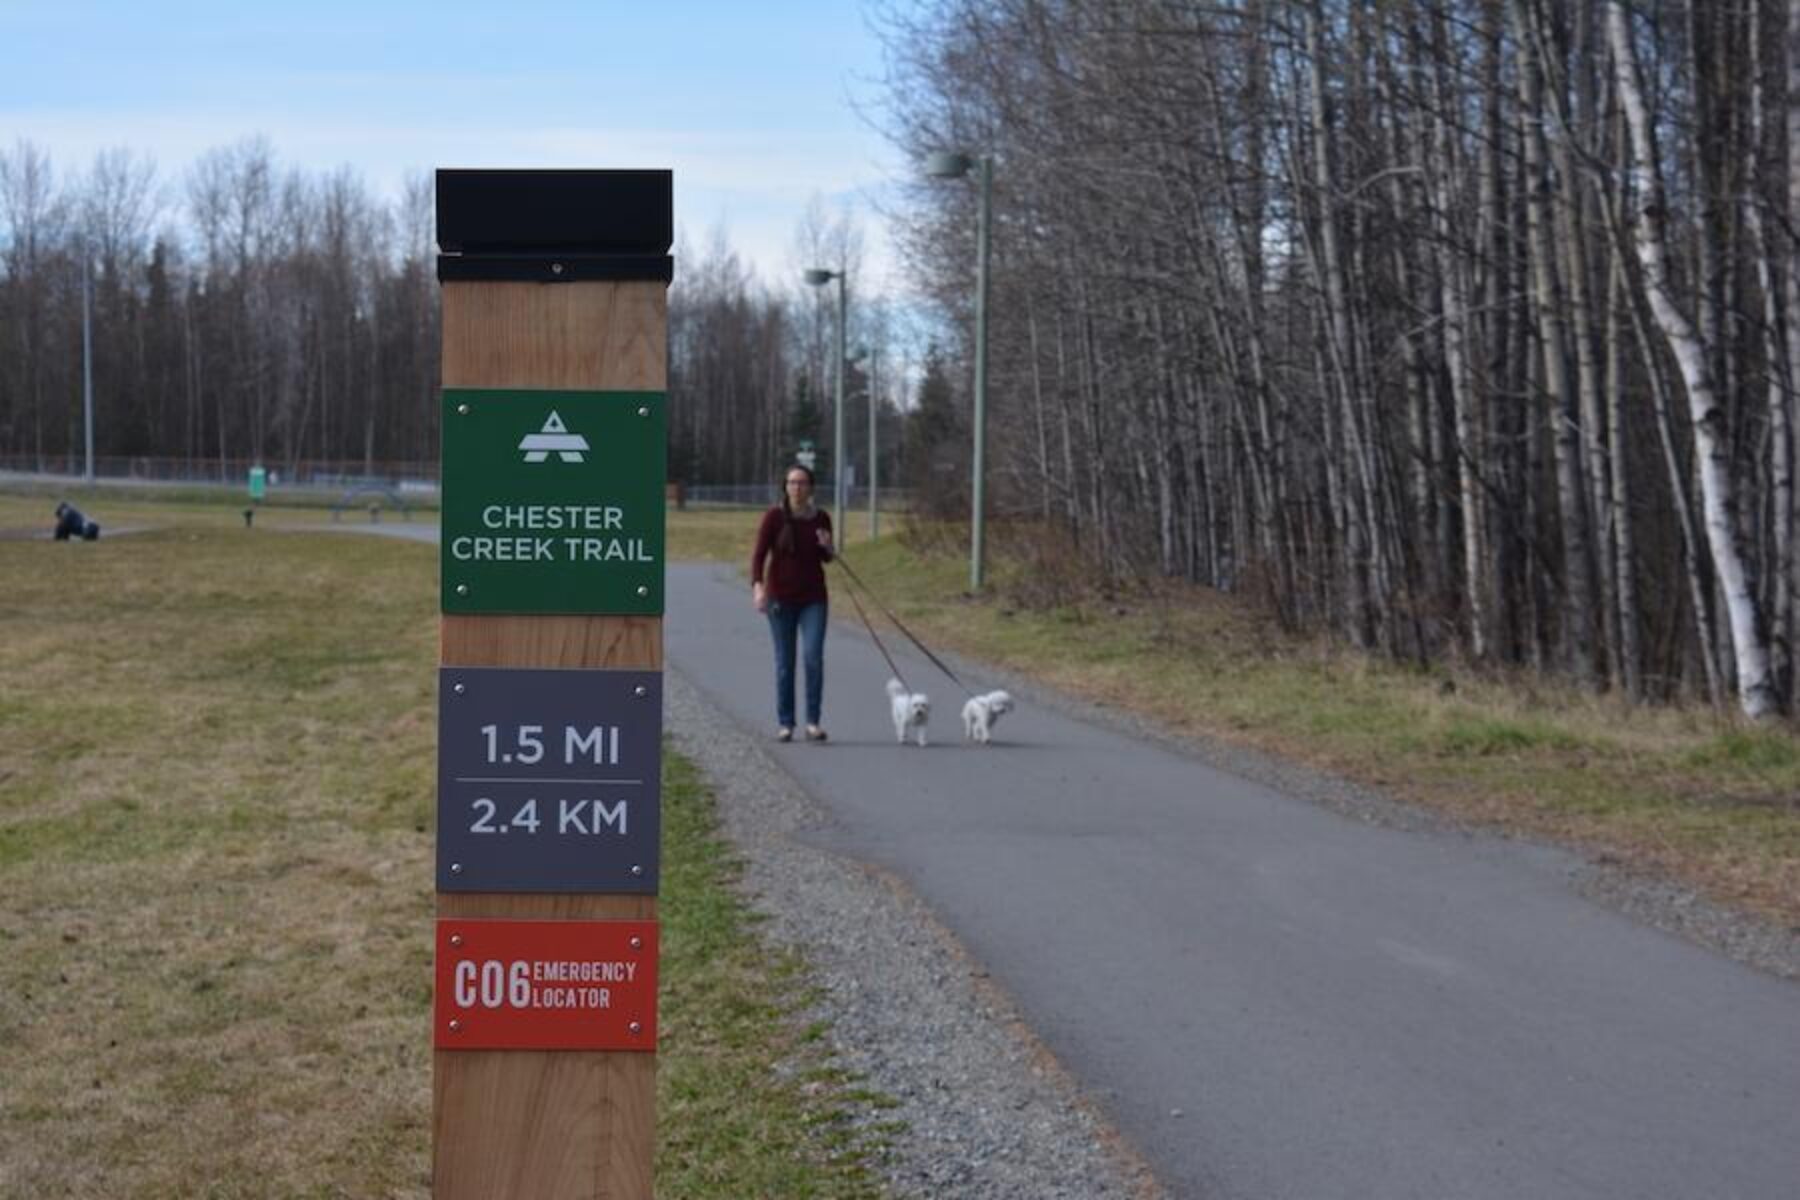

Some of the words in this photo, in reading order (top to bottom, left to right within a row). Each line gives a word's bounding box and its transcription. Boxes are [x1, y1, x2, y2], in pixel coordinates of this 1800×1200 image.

[482, 505, 623, 529] CHESTER
[451, 537, 554, 561] CREEK
[564, 538, 654, 562] TRAIL
[481, 724, 545, 764] 1.5
[565, 726, 619, 765] MI
[470, 798, 541, 833] 2.4
[559, 799, 627, 835] KM
[533, 961, 637, 982] EMERGENCY
[533, 987, 611, 1009] LOCATOR
